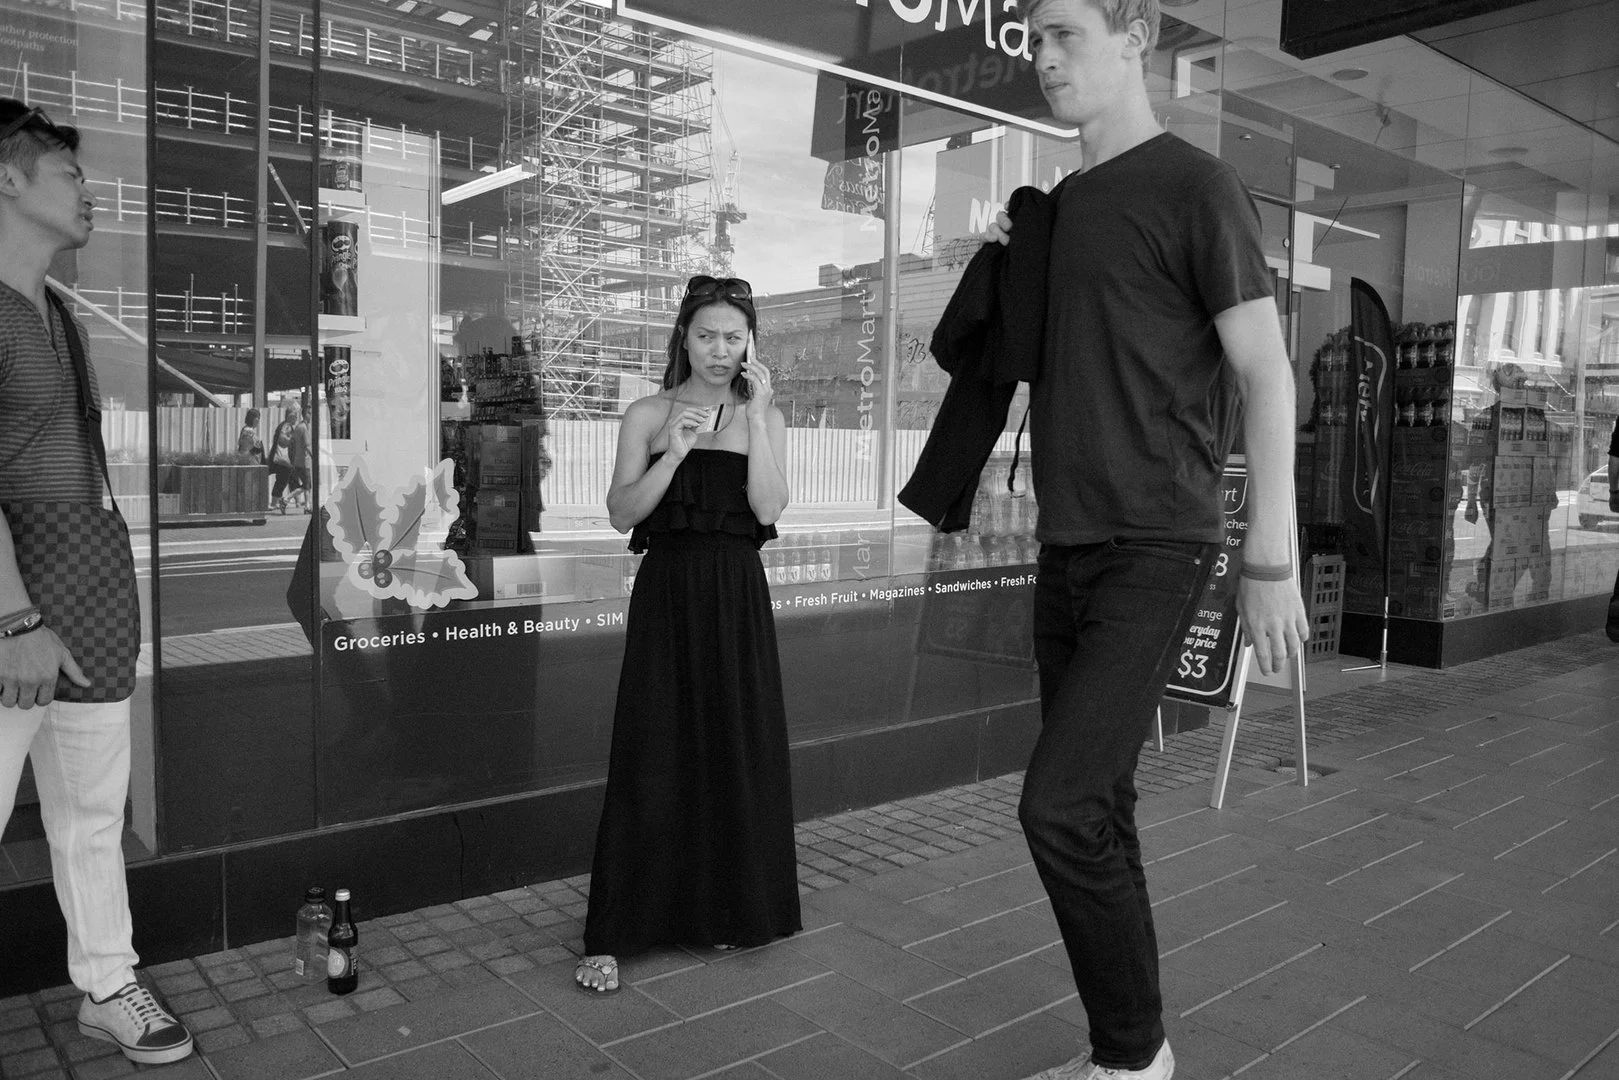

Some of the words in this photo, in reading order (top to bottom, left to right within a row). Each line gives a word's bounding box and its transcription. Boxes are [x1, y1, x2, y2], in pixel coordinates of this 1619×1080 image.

[857, 293, 876, 460] MetroMart
[1226, 536, 1241, 546] for
[334, 630, 426, 651] Groceries
[445, 622, 502, 641] Health
[507, 621, 519, 635] &
[524, 616, 579, 634] Beauty
[597, 612, 624, 626] SIM
[795, 593, 828, 608] Fresh
[831, 590, 858, 604] Fruit
[870, 586, 925, 601] Magazines
[935, 578, 992, 594] Sandwiches
[1001, 575, 1026, 588] Fresh
[1197, 609, 1223, 622] ange
[1193, 638, 1218, 650] price
[1177, 650, 1209, 679] $3
